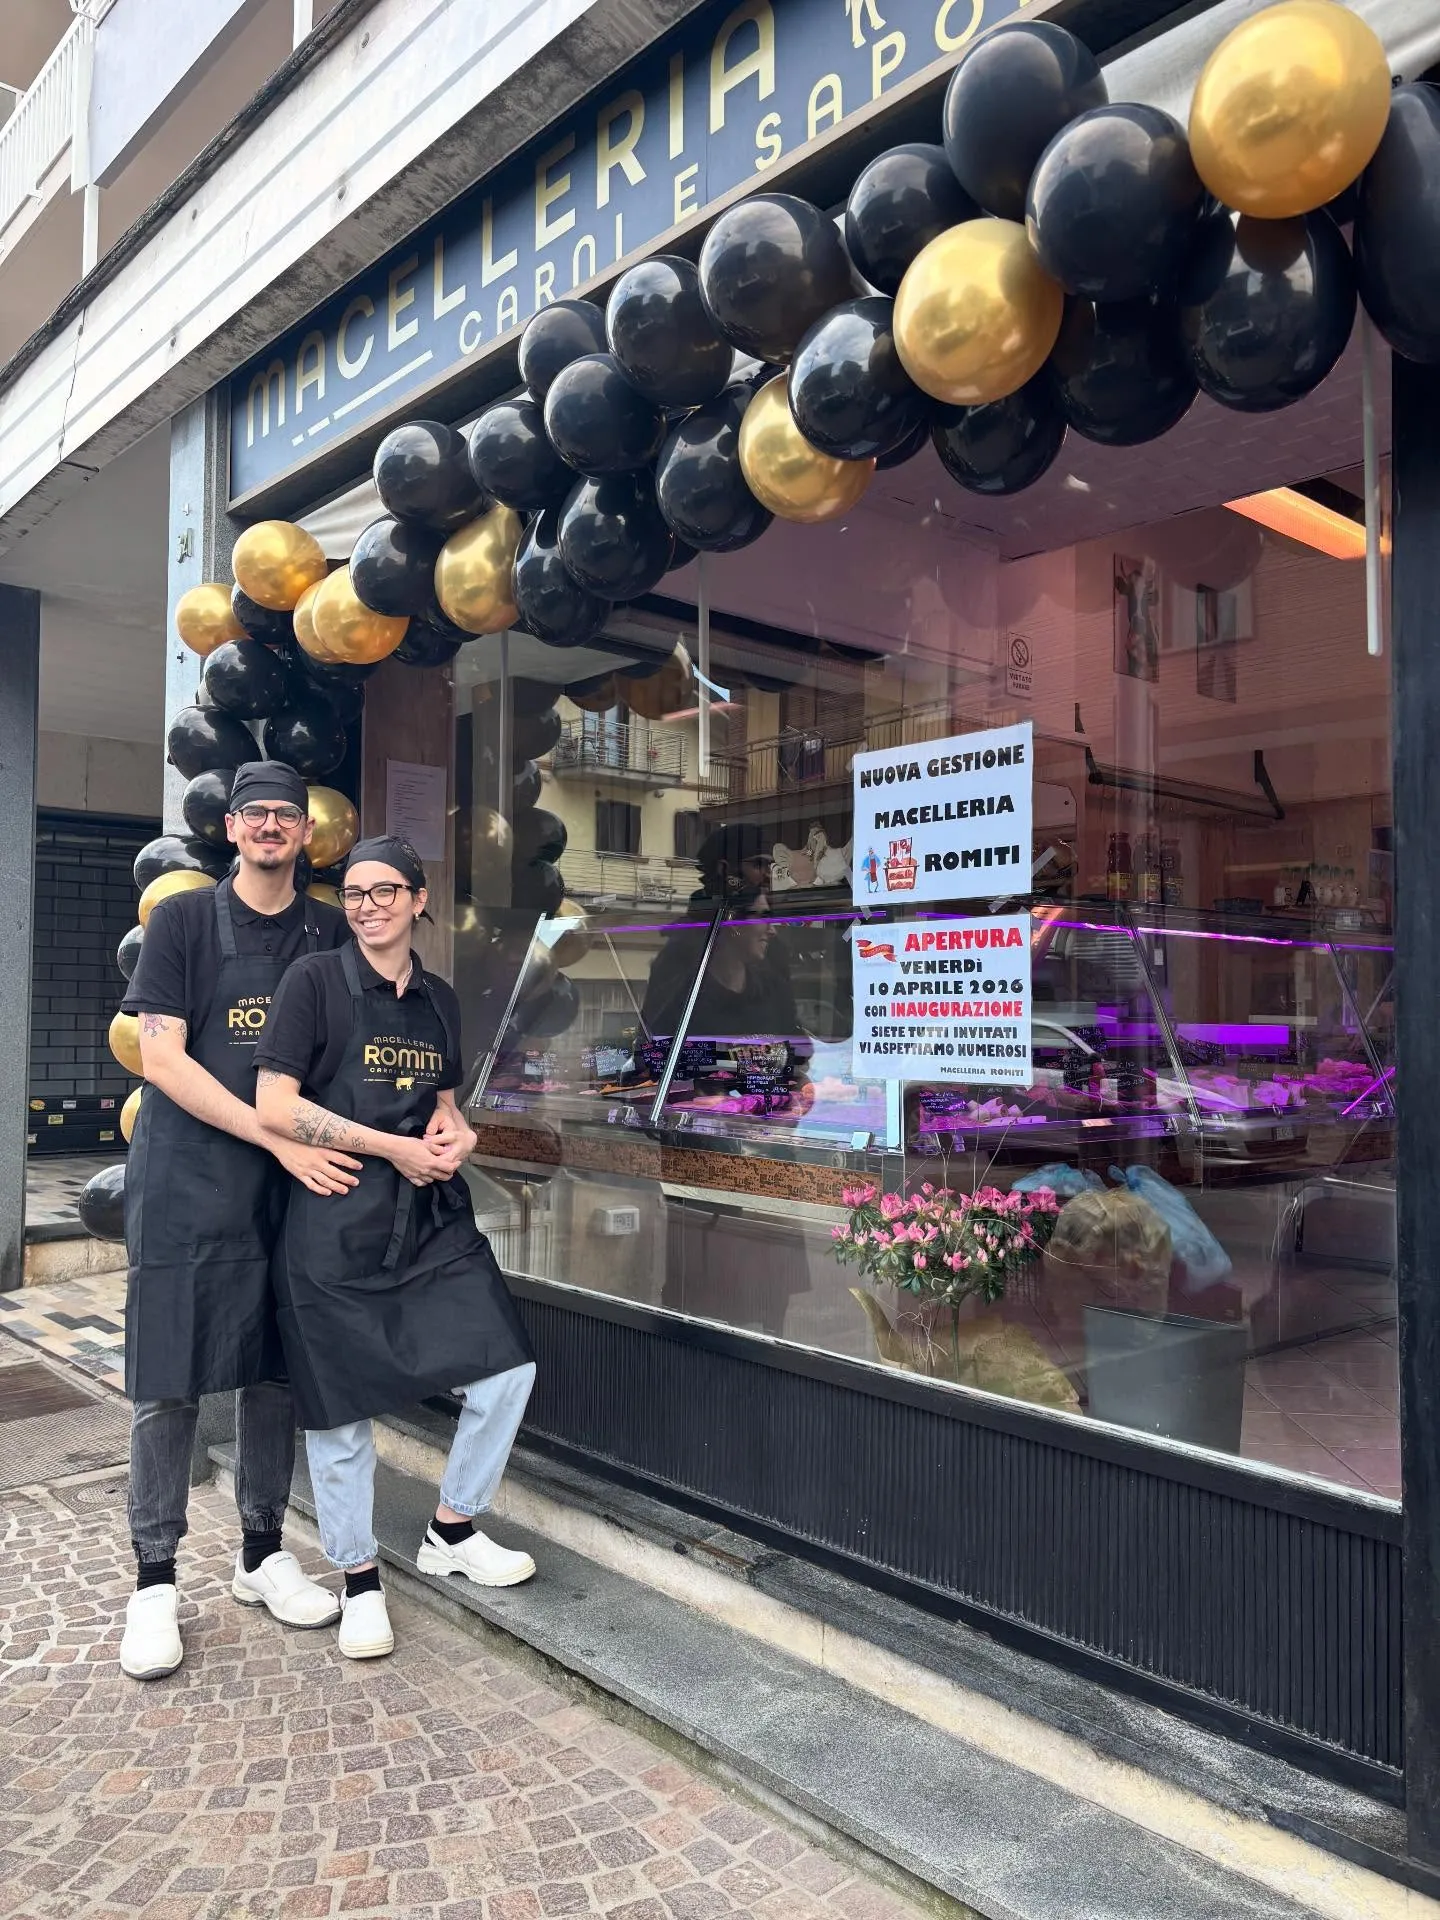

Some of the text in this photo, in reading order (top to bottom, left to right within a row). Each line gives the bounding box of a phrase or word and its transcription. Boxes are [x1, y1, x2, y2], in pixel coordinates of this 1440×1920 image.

[459, 0, 1030, 355] CARNI E SAPO
[246, 0, 776, 448] MACELLERIA
[860, 744, 1024, 788] NUOVA GESTIONE
[874, 795, 1014, 829] MACELLERIA
[925, 845, 1020, 872] ROMITI
[904, 927, 1023, 952] APERTURA
[869, 978, 1024, 996] 10 APRILE 2026
[238, 996, 272, 1007] MACE
[864, 1001, 1023, 1017] con INAUGURAZIONE
[228, 1008, 267, 1028] RO
[871, 1026, 1018, 1039] SIETE TUTTI INVITATI
[373, 1036, 435, 1050] MACELLERIA
[859, 1042, 1027, 1058] VI ASPETTIAMO NUMEROSI
[364, 1044, 443, 1072] ROMITI
[940, 1066, 1024, 1077] MACELLERIA ROMITI
